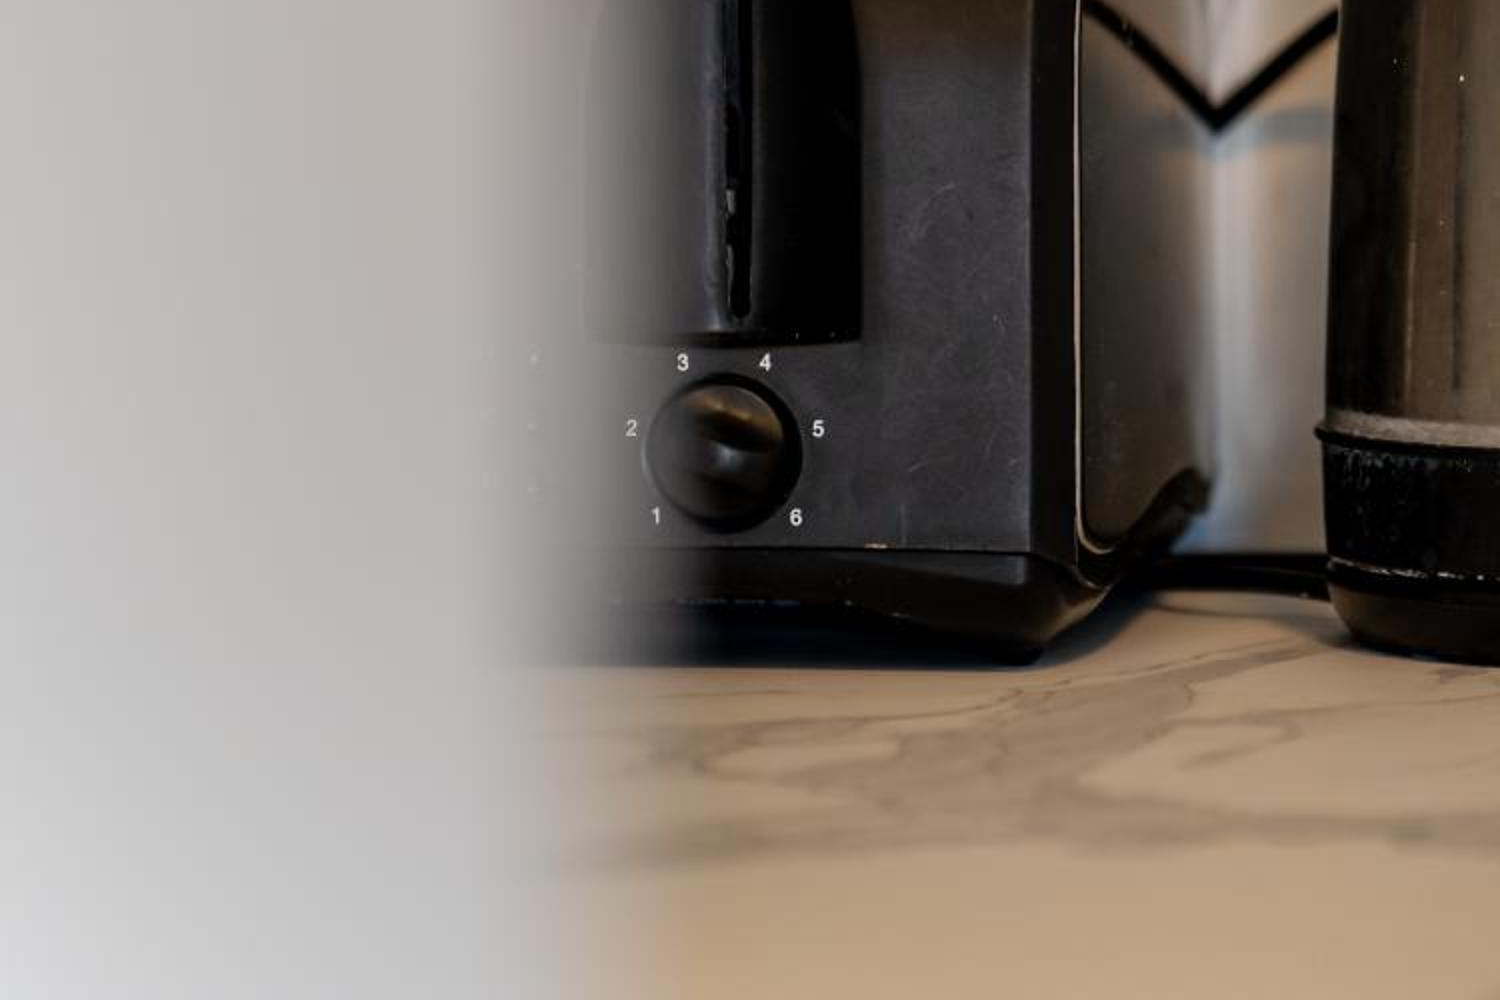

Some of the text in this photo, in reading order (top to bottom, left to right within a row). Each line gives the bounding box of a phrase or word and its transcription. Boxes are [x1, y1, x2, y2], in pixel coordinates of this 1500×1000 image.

[677, 353, 689, 372] 3
[759, 353, 772, 372] 4
[625, 419, 638, 437] 2
[812, 419, 825, 438] 5
[651, 506, 661, 525] 1
[789, 508, 803, 527] 6
